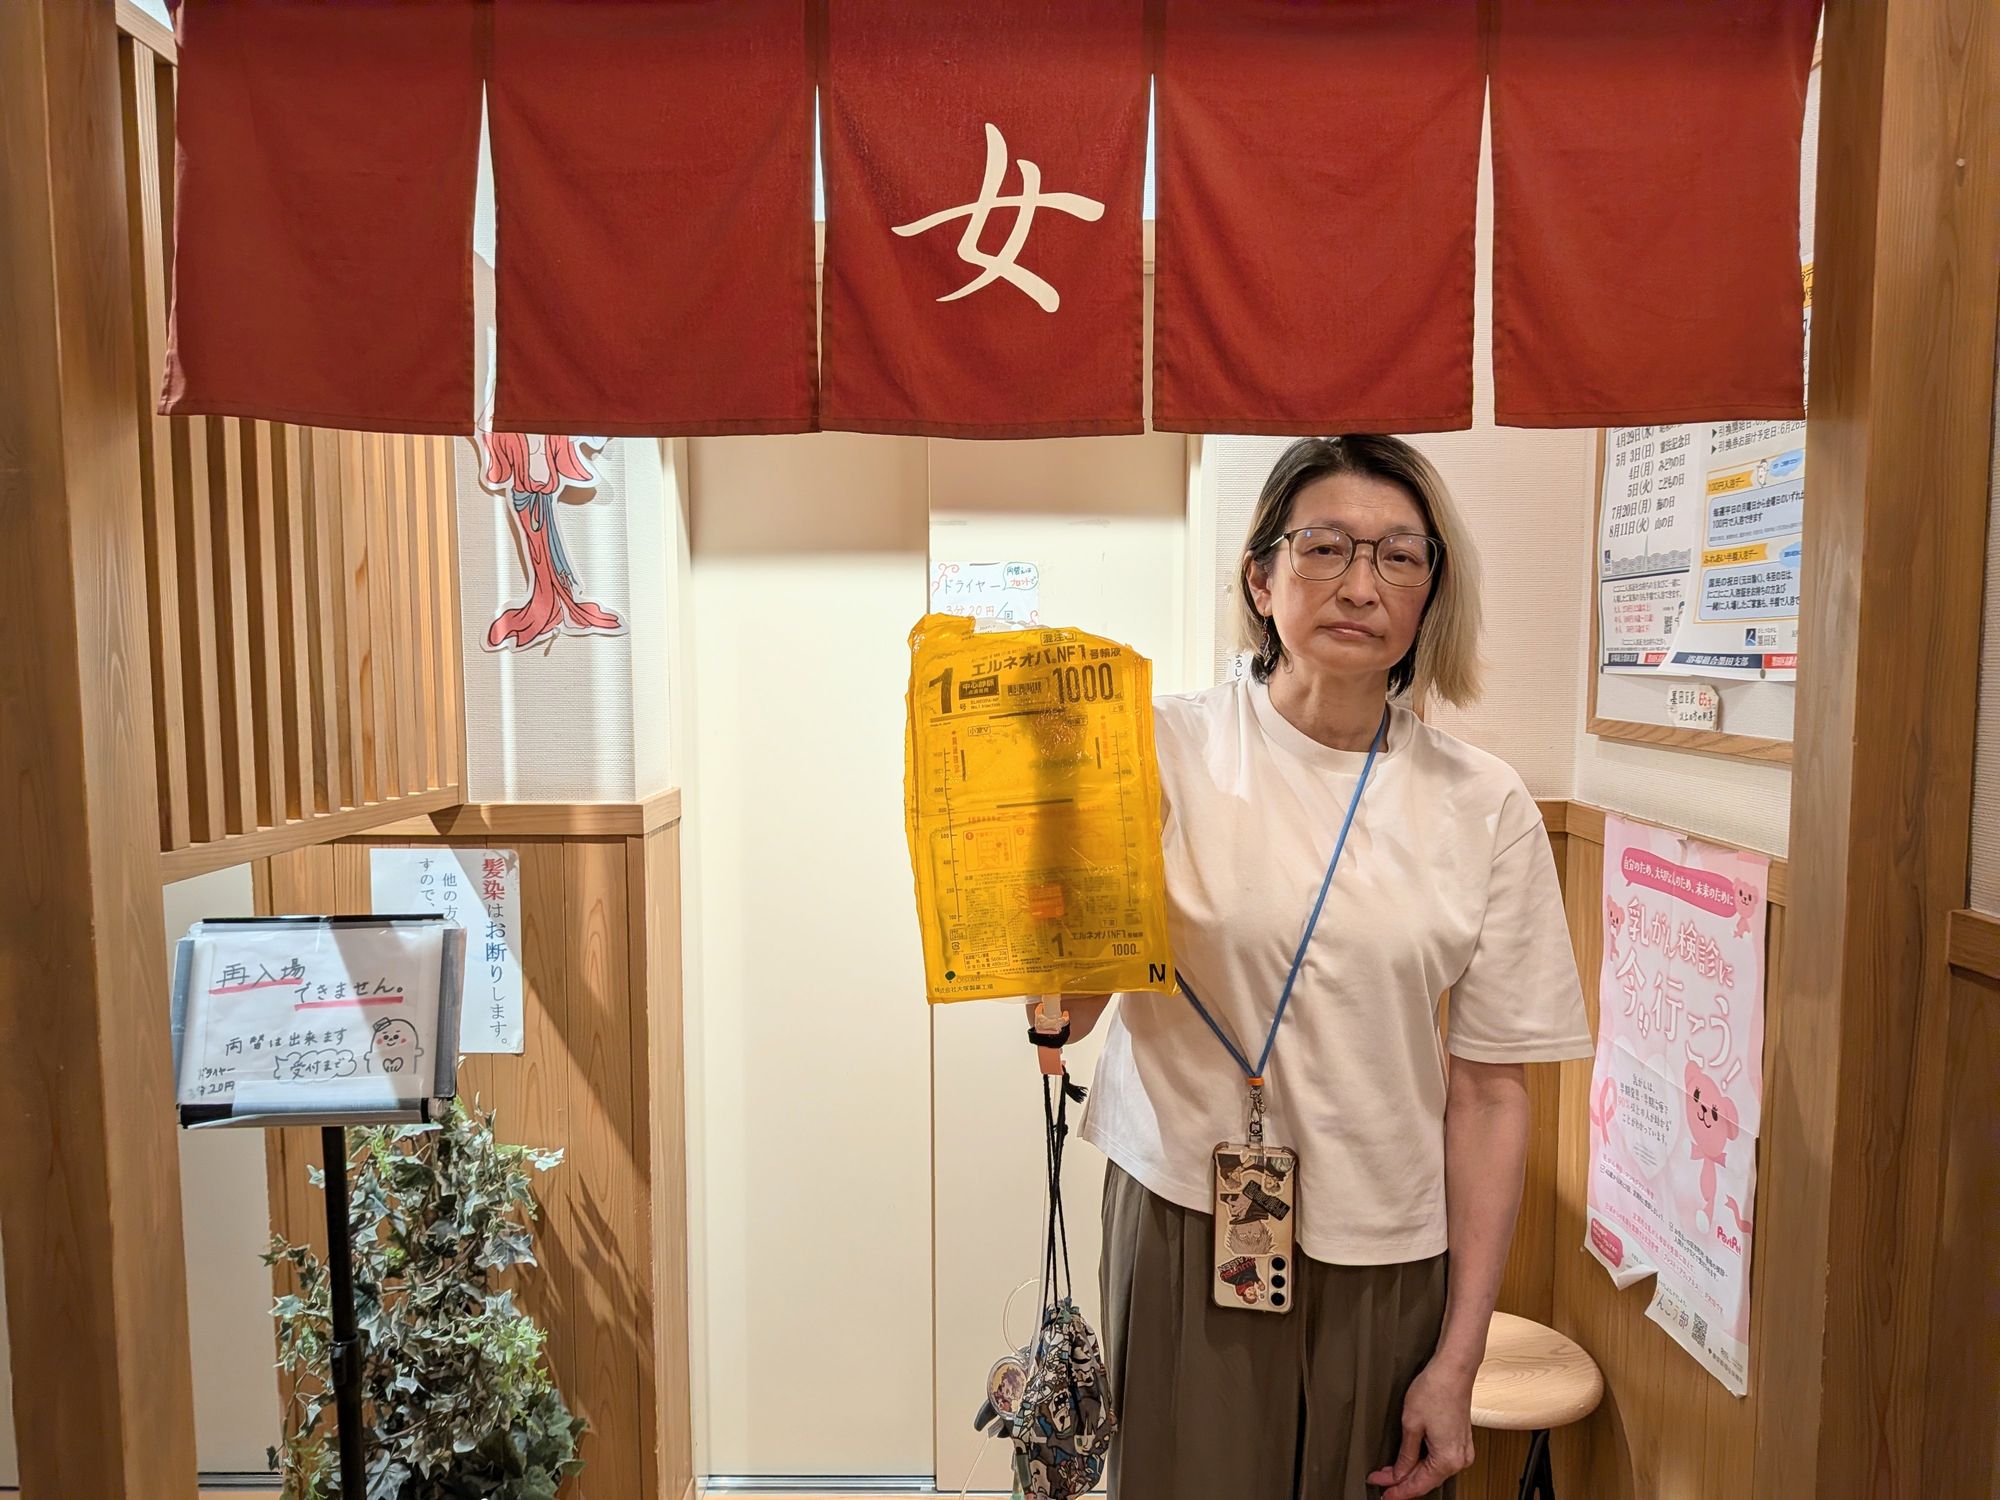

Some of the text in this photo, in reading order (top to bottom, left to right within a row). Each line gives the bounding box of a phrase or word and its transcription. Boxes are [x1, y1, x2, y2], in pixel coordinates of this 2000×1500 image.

[891, 122, 1105, 313] 女
[945, 579, 1000, 594] ドライヤー
[929, 667, 953, 714] 1
[1053, 663, 1114, 704] 1000
[482, 858, 508, 1045] 髪染はお断りします。
[1112, 943, 1136, 956] 1000
[1627, 898, 1735, 988] 乳がん検診に
[216, 958, 306, 988] 再入場
[295, 978, 404, 1003] できません。
[226, 1028, 348, 1055] 両替は出来ます
[290, 1058, 345, 1080] 受付まで
